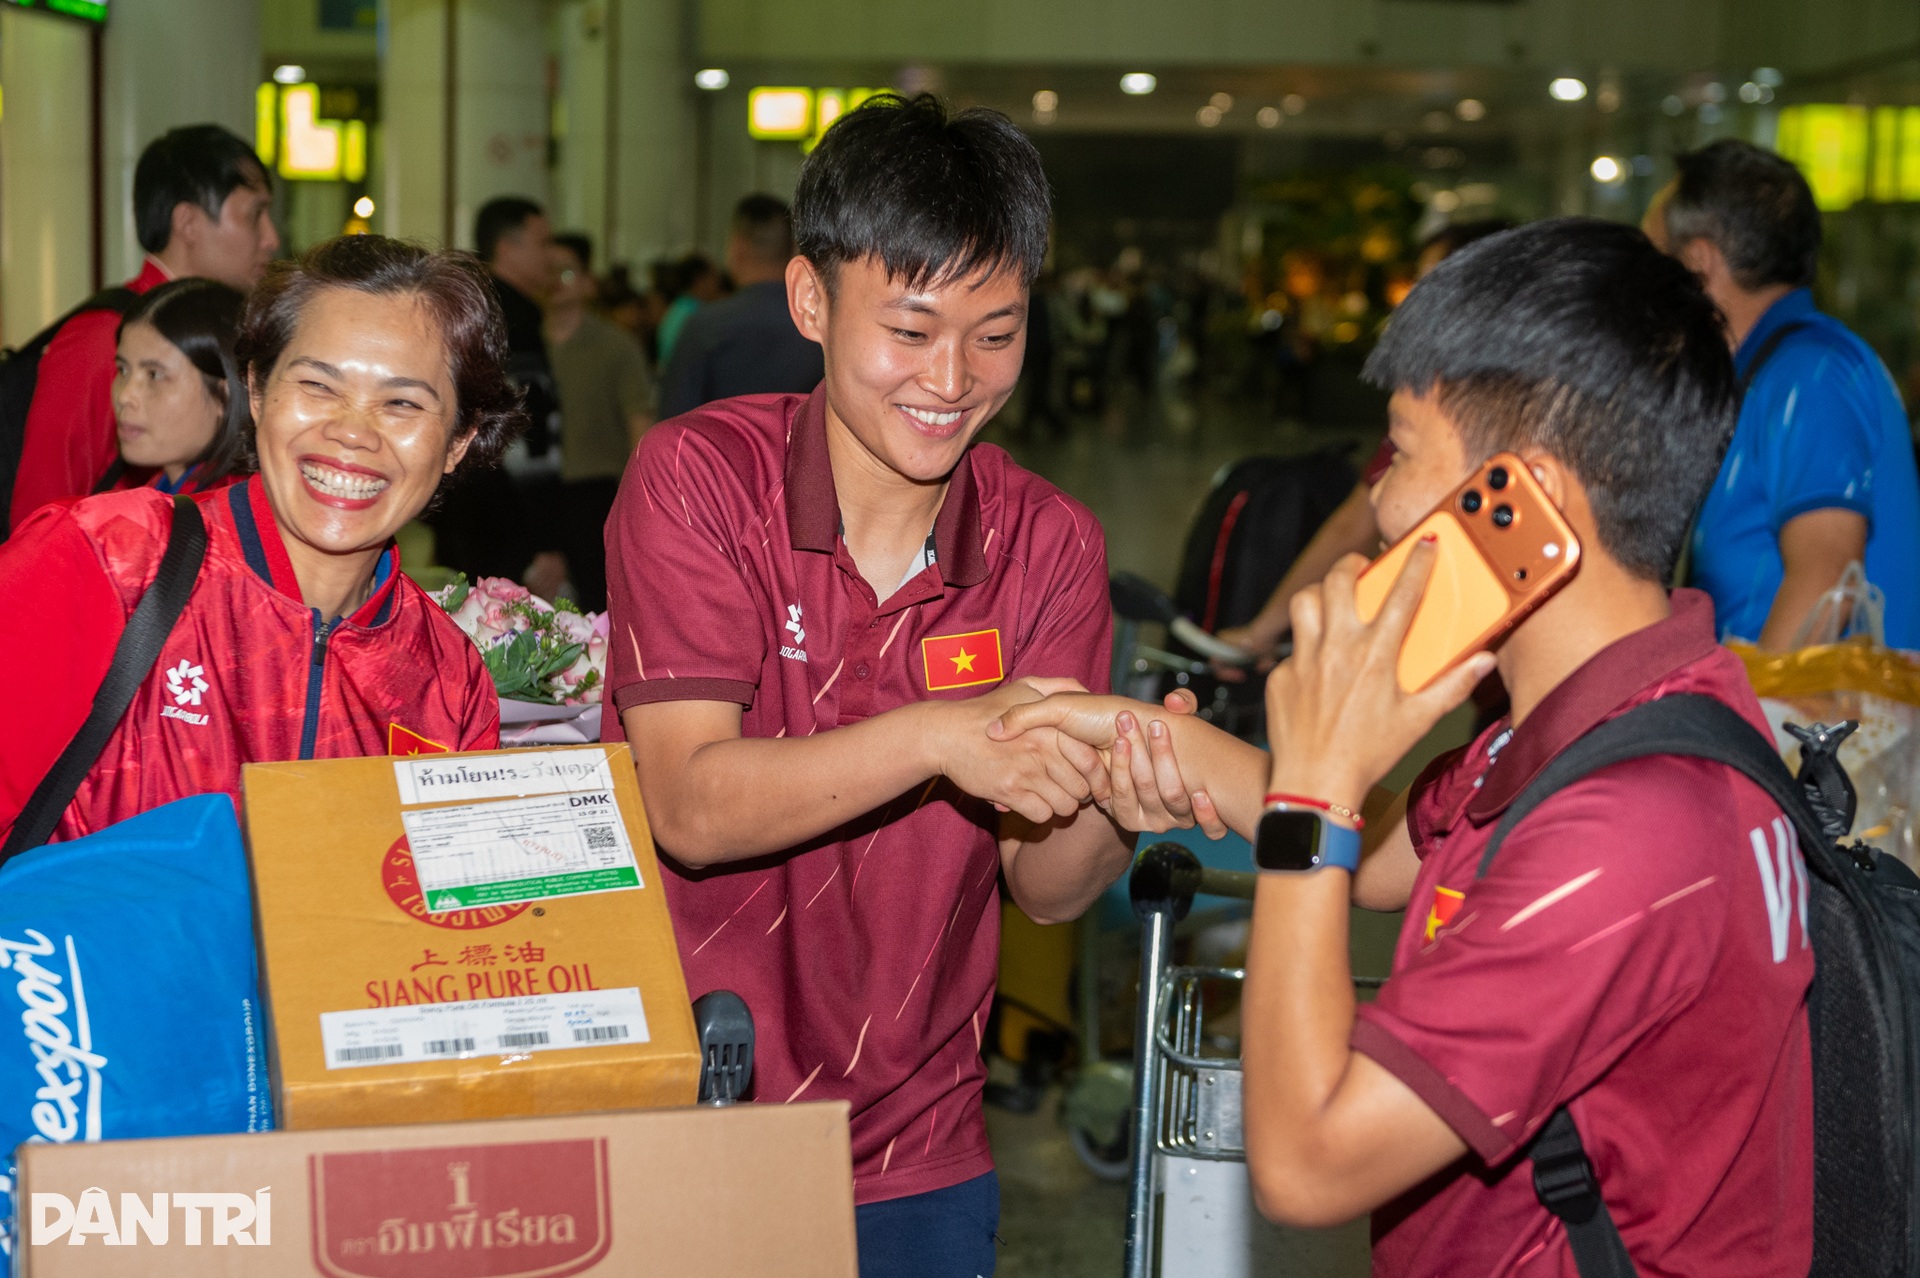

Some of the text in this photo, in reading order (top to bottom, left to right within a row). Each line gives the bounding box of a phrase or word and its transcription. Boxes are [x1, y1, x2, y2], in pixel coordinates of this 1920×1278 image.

[569, 794, 611, 808] DMK
[410, 941, 546, 972] 上標油
[365, 963, 601, 1009] SIANG PURE OIL
